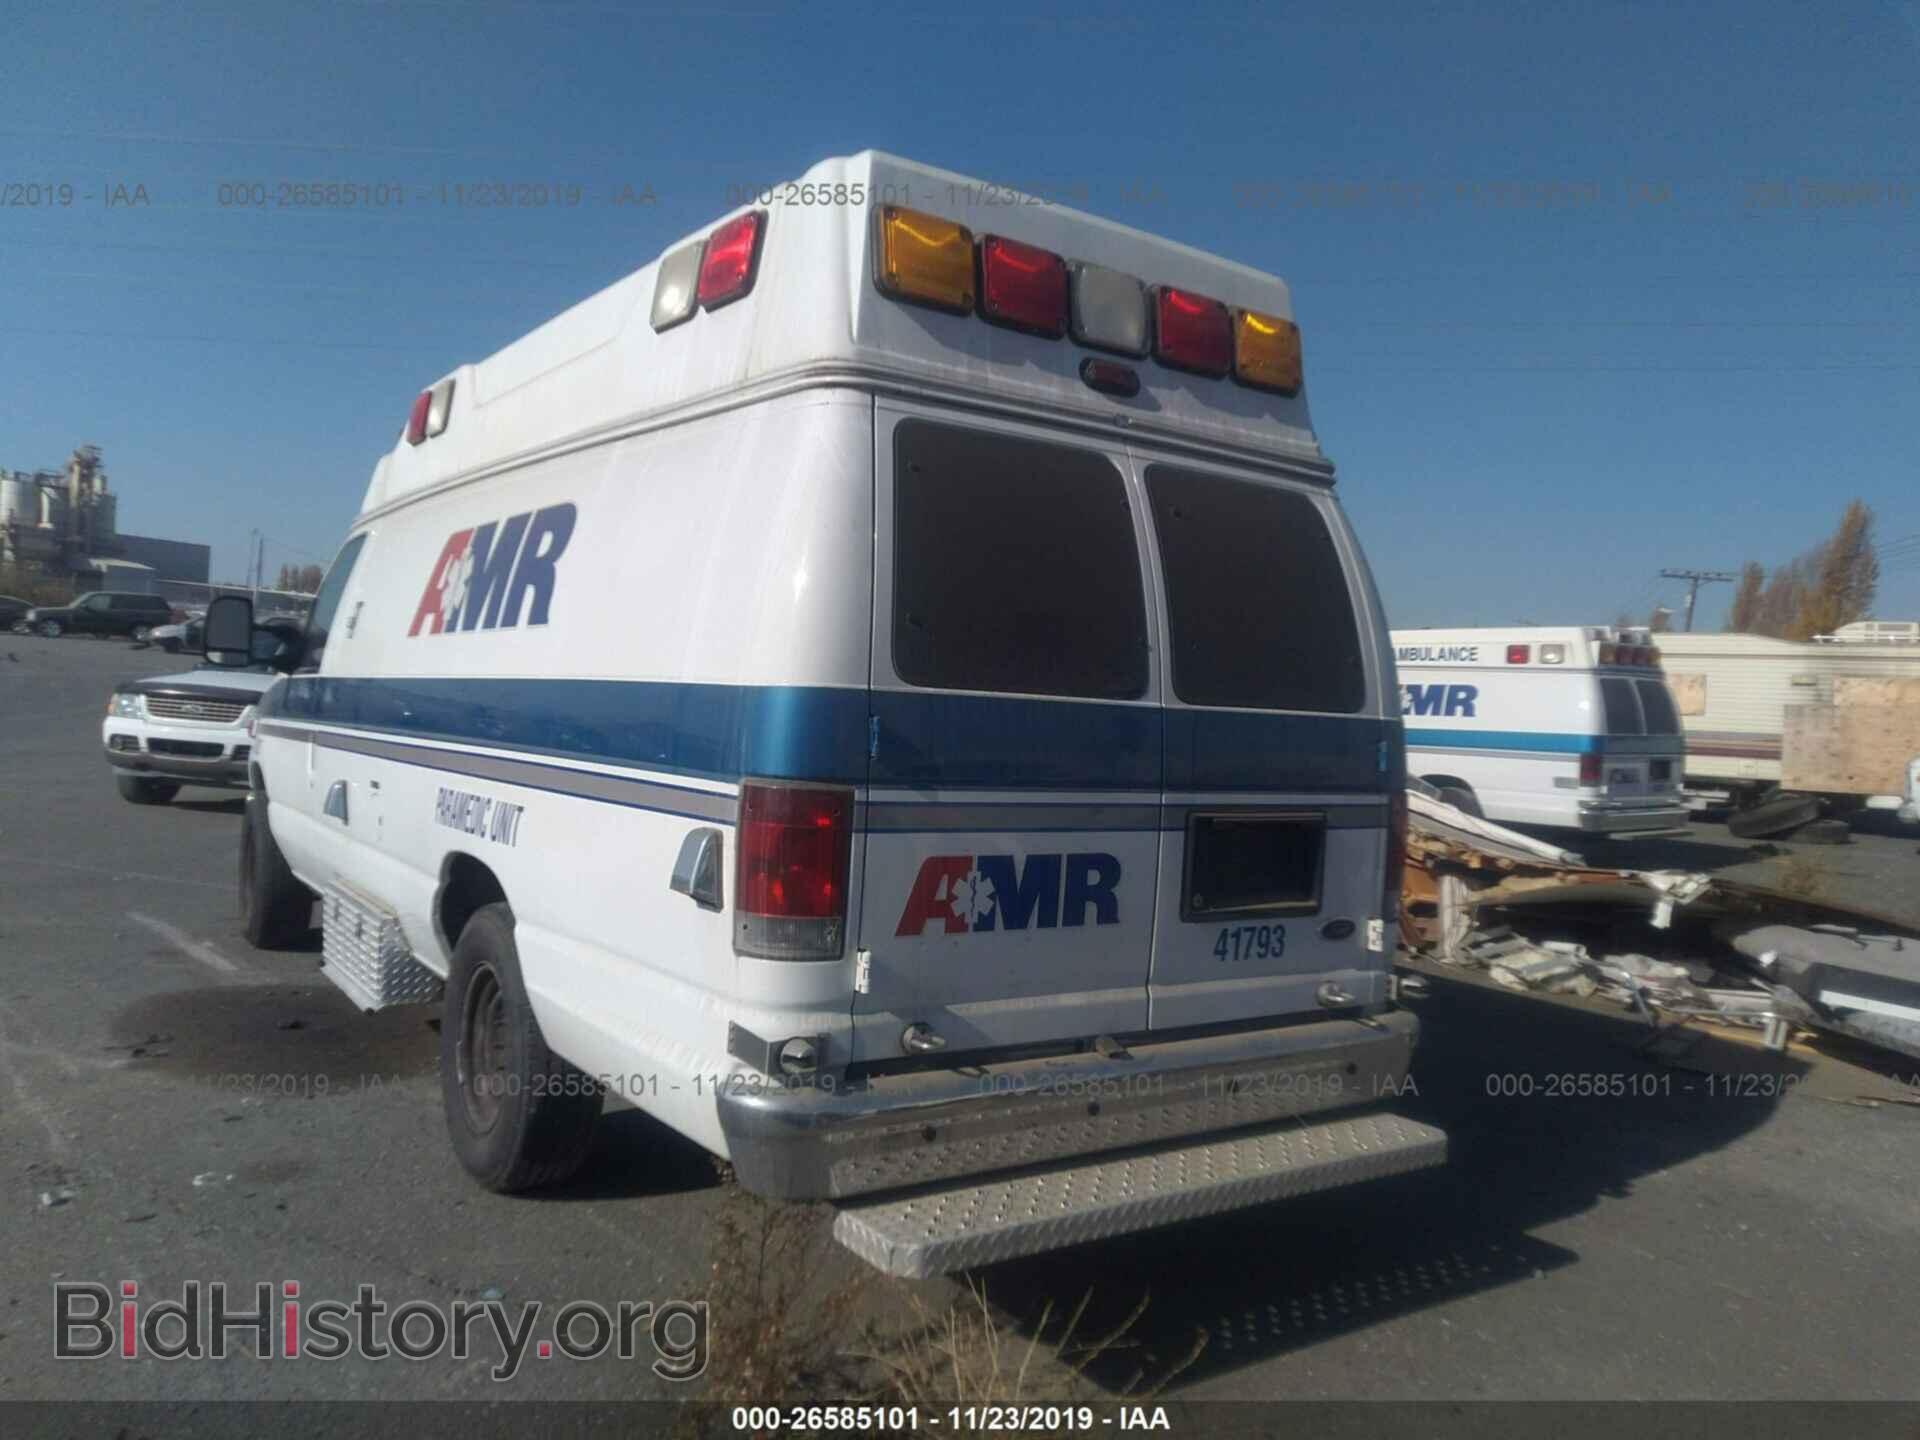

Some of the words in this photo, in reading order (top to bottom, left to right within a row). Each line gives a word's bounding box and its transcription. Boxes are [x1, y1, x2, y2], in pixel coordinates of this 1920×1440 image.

[408, 502, 577, 637] AMR
[1394, 646, 1479, 662] MBULANCE
[1397, 684, 1478, 717] MR
[435, 787, 493, 838] PARAMEDIC
[491, 800, 524, 848] UNIT
[895, 852, 1121, 937] AMR
[1213, 924, 1286, 962] 41793
